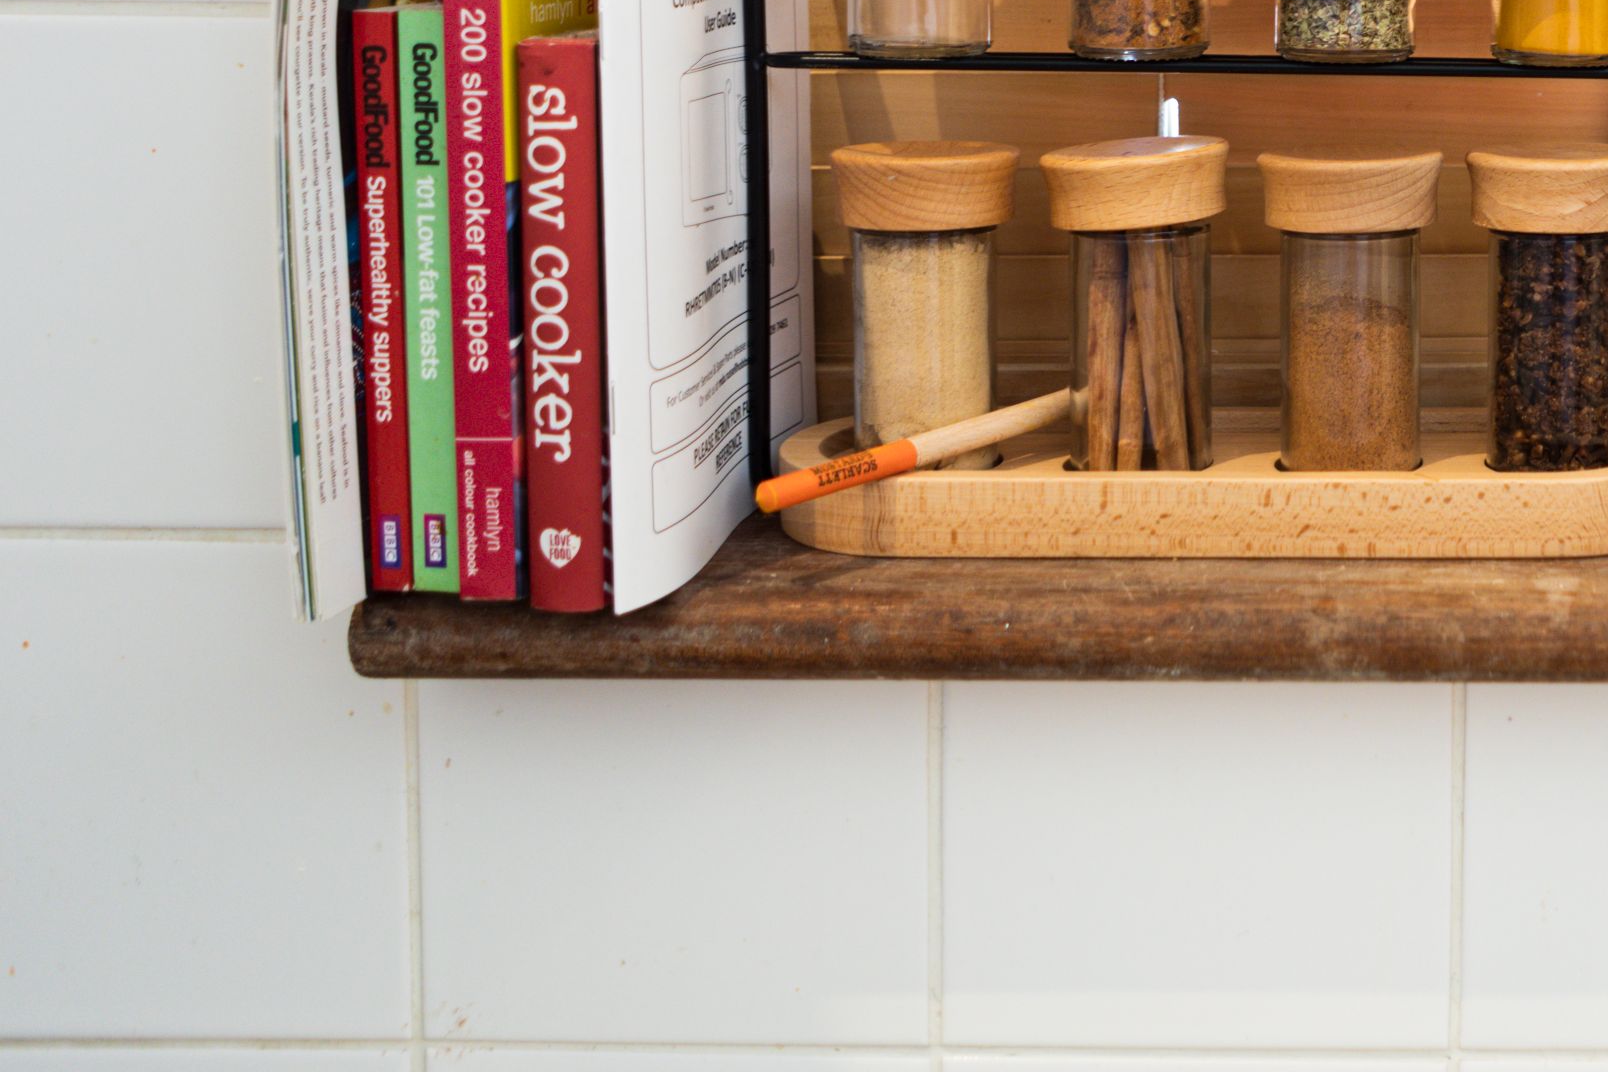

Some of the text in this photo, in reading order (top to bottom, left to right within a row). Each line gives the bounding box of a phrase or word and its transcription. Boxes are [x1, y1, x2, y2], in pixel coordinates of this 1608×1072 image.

[717, 8, 737, 29] Guide
[412, 42, 440, 381] GoodFood 101 Low-fat feasts
[460, 8, 493, 373] 200 slow cooker recipes
[361, 45, 393, 424] GoodFood Superhealthy suppers
[527, 84, 582, 463] slow cooker
[694, 432, 714, 465] PLEASE
[383, 521, 398, 563] BBC
[463, 449, 479, 577] all colour cookbook
[485, 487, 503, 553] hamlyn
[550, 534, 571, 547] LOVE
[550, 547, 572, 560] FOOD
